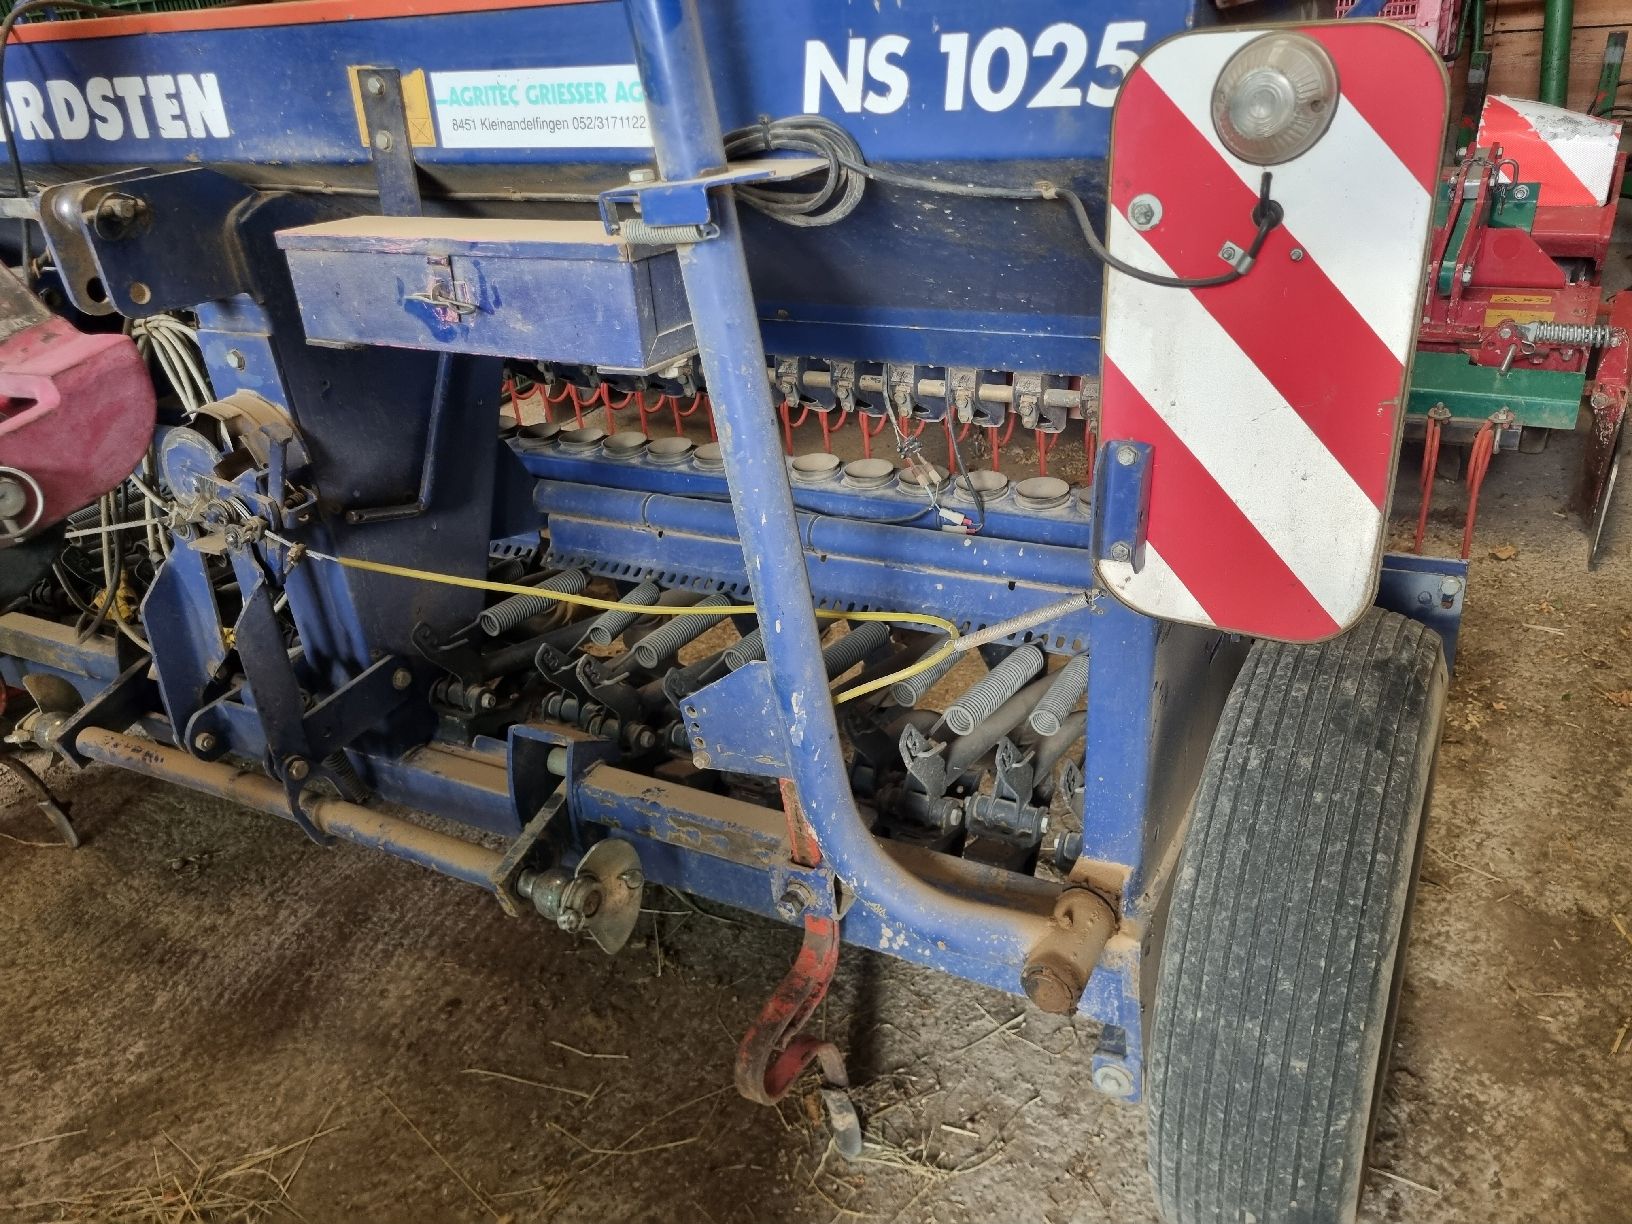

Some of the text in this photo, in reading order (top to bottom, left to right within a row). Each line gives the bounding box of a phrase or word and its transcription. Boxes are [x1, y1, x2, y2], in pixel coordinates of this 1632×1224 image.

[803, 20, 1146, 114] NS 1025
[449, 81, 646, 106] AGRITEC GRIESSER AG
[452, 115, 646, 133] 8451 Kleinandelfingen 052/3171122
